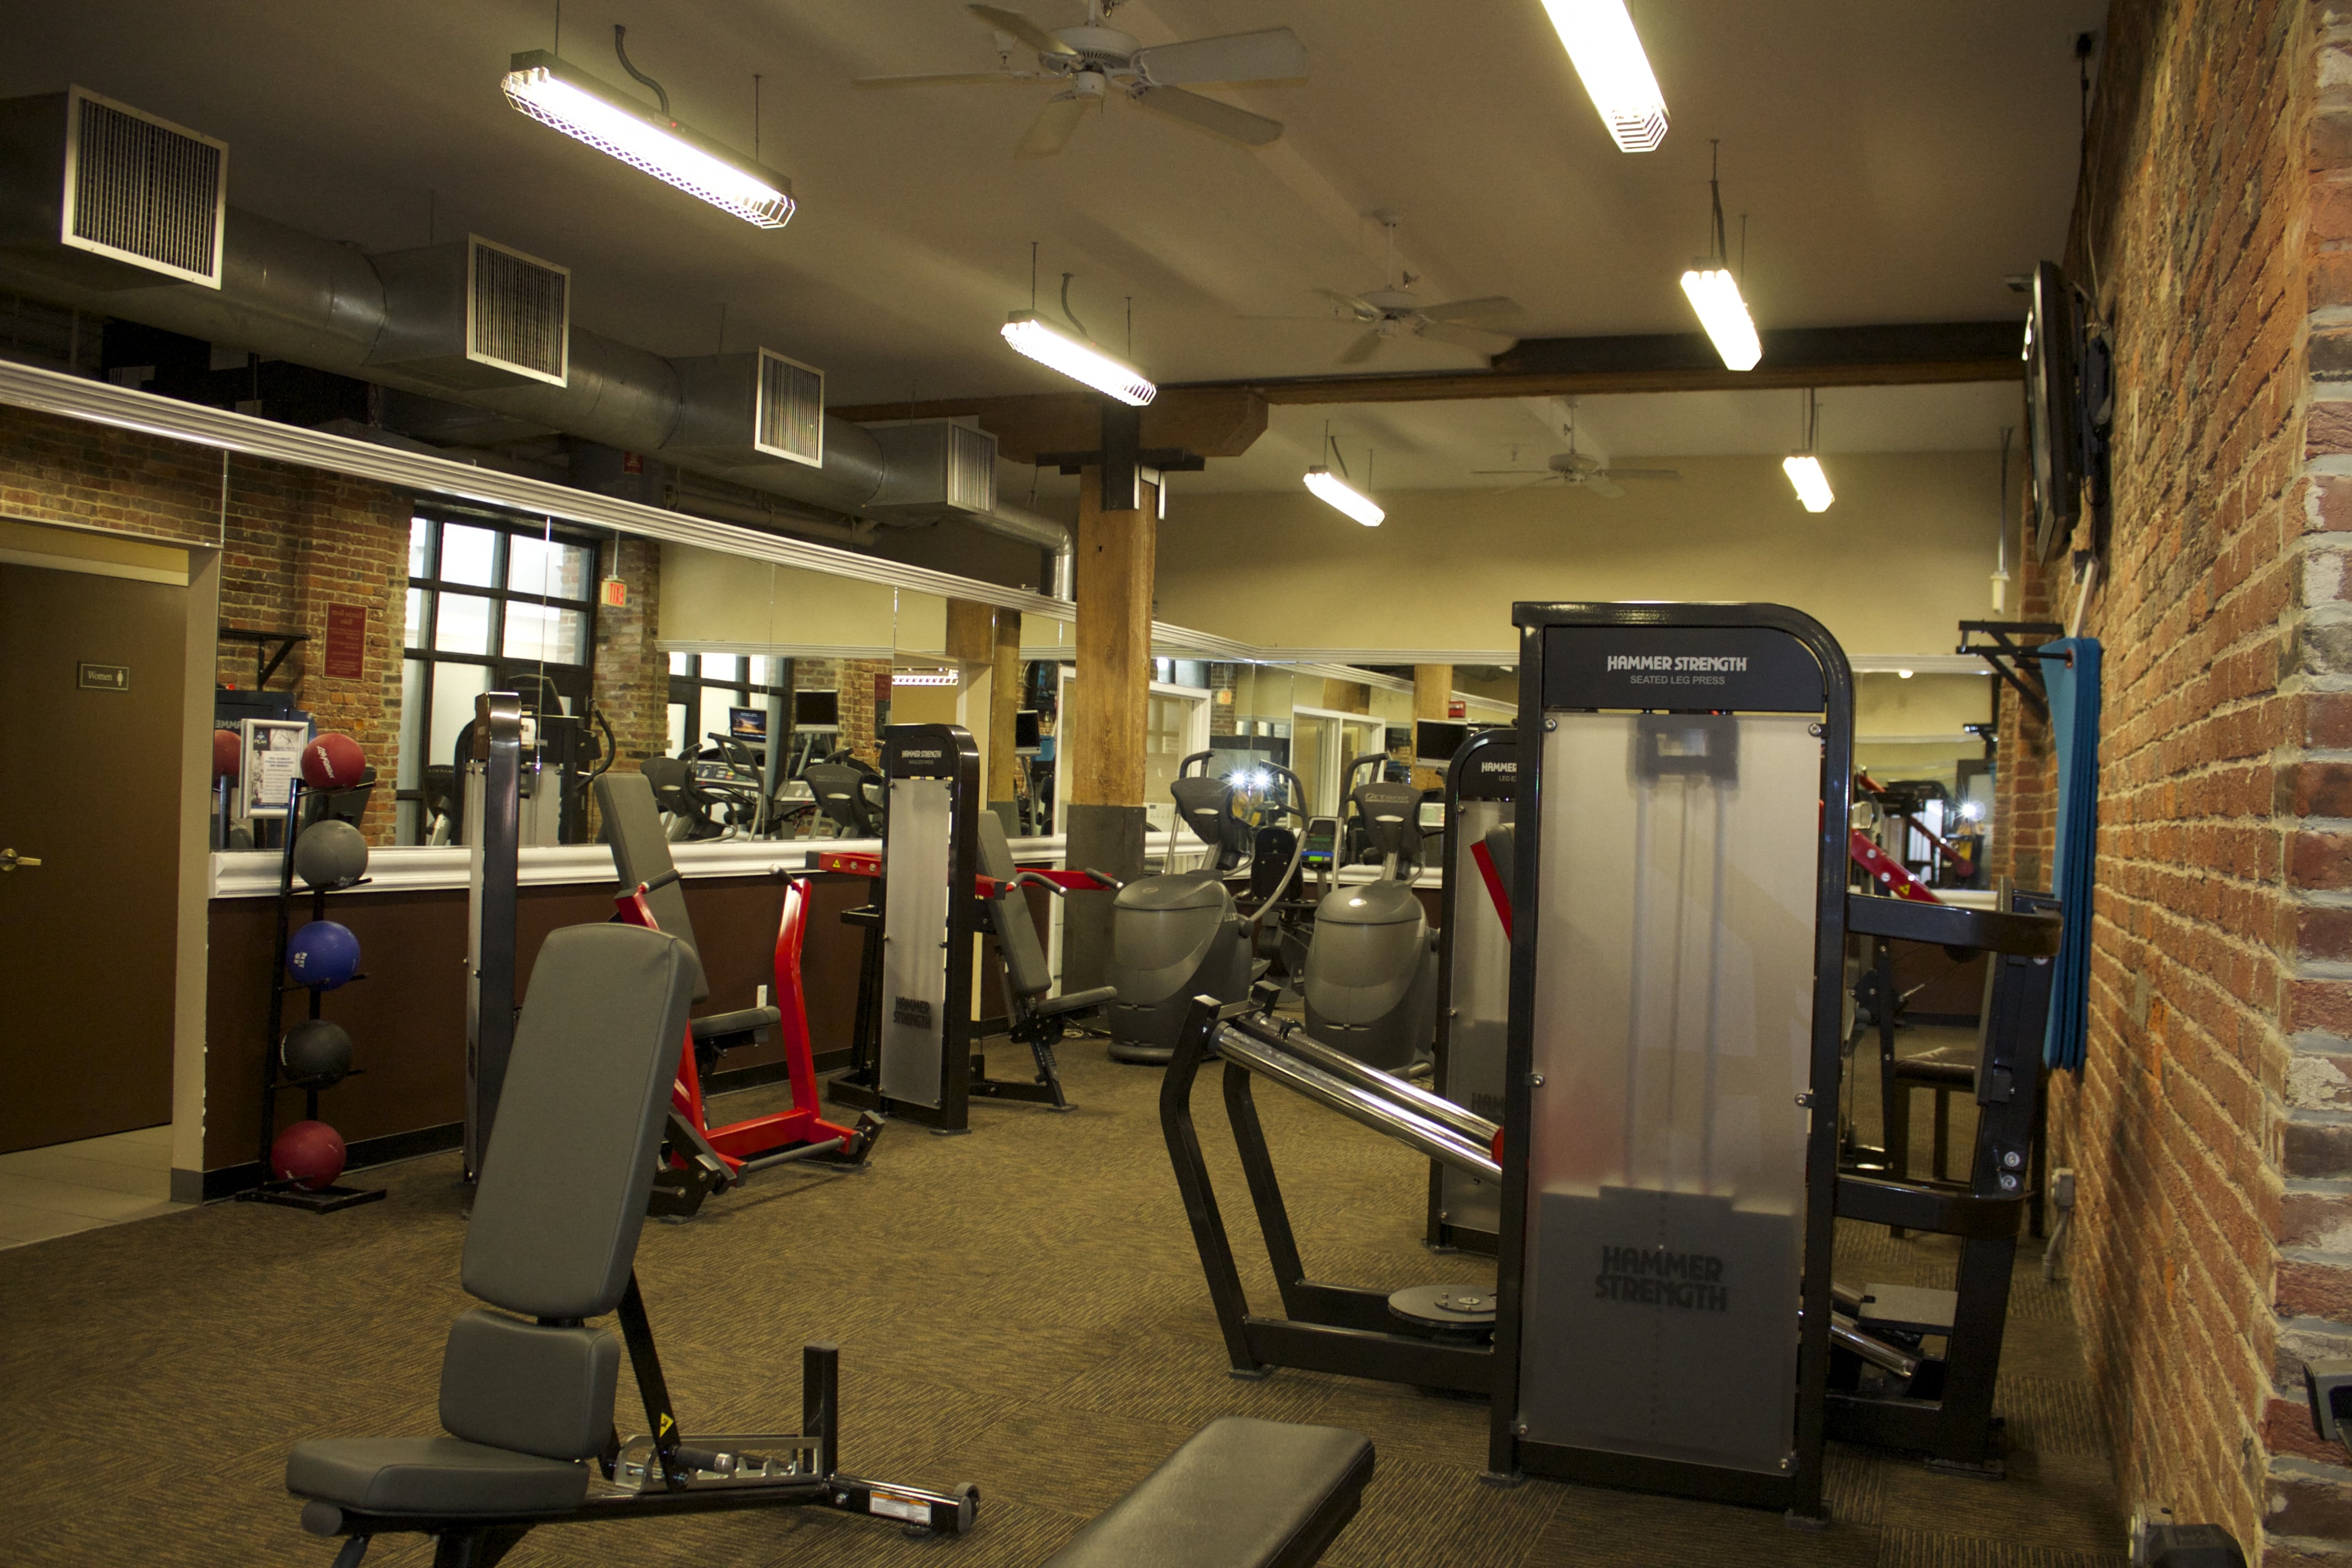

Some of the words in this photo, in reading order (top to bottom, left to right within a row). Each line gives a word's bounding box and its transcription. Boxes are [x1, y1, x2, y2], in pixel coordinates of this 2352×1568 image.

[1607, 655, 1672, 672] HAMMER
[1674, 656, 1747, 672] STRENGTH
[88, 671, 113, 681] Women
[1630, 675, 1668, 684] SEATED
[1670, 676, 1690, 684] LEG
[1692, 676, 1725, 685] PRESS
[896, 996, 930, 1014] HAMMER
[894, 1011, 932, 1029] STRENGTH
[1602, 1246, 1723, 1282] HAMMER
[1595, 1274, 1727, 1313] STRENGTH
